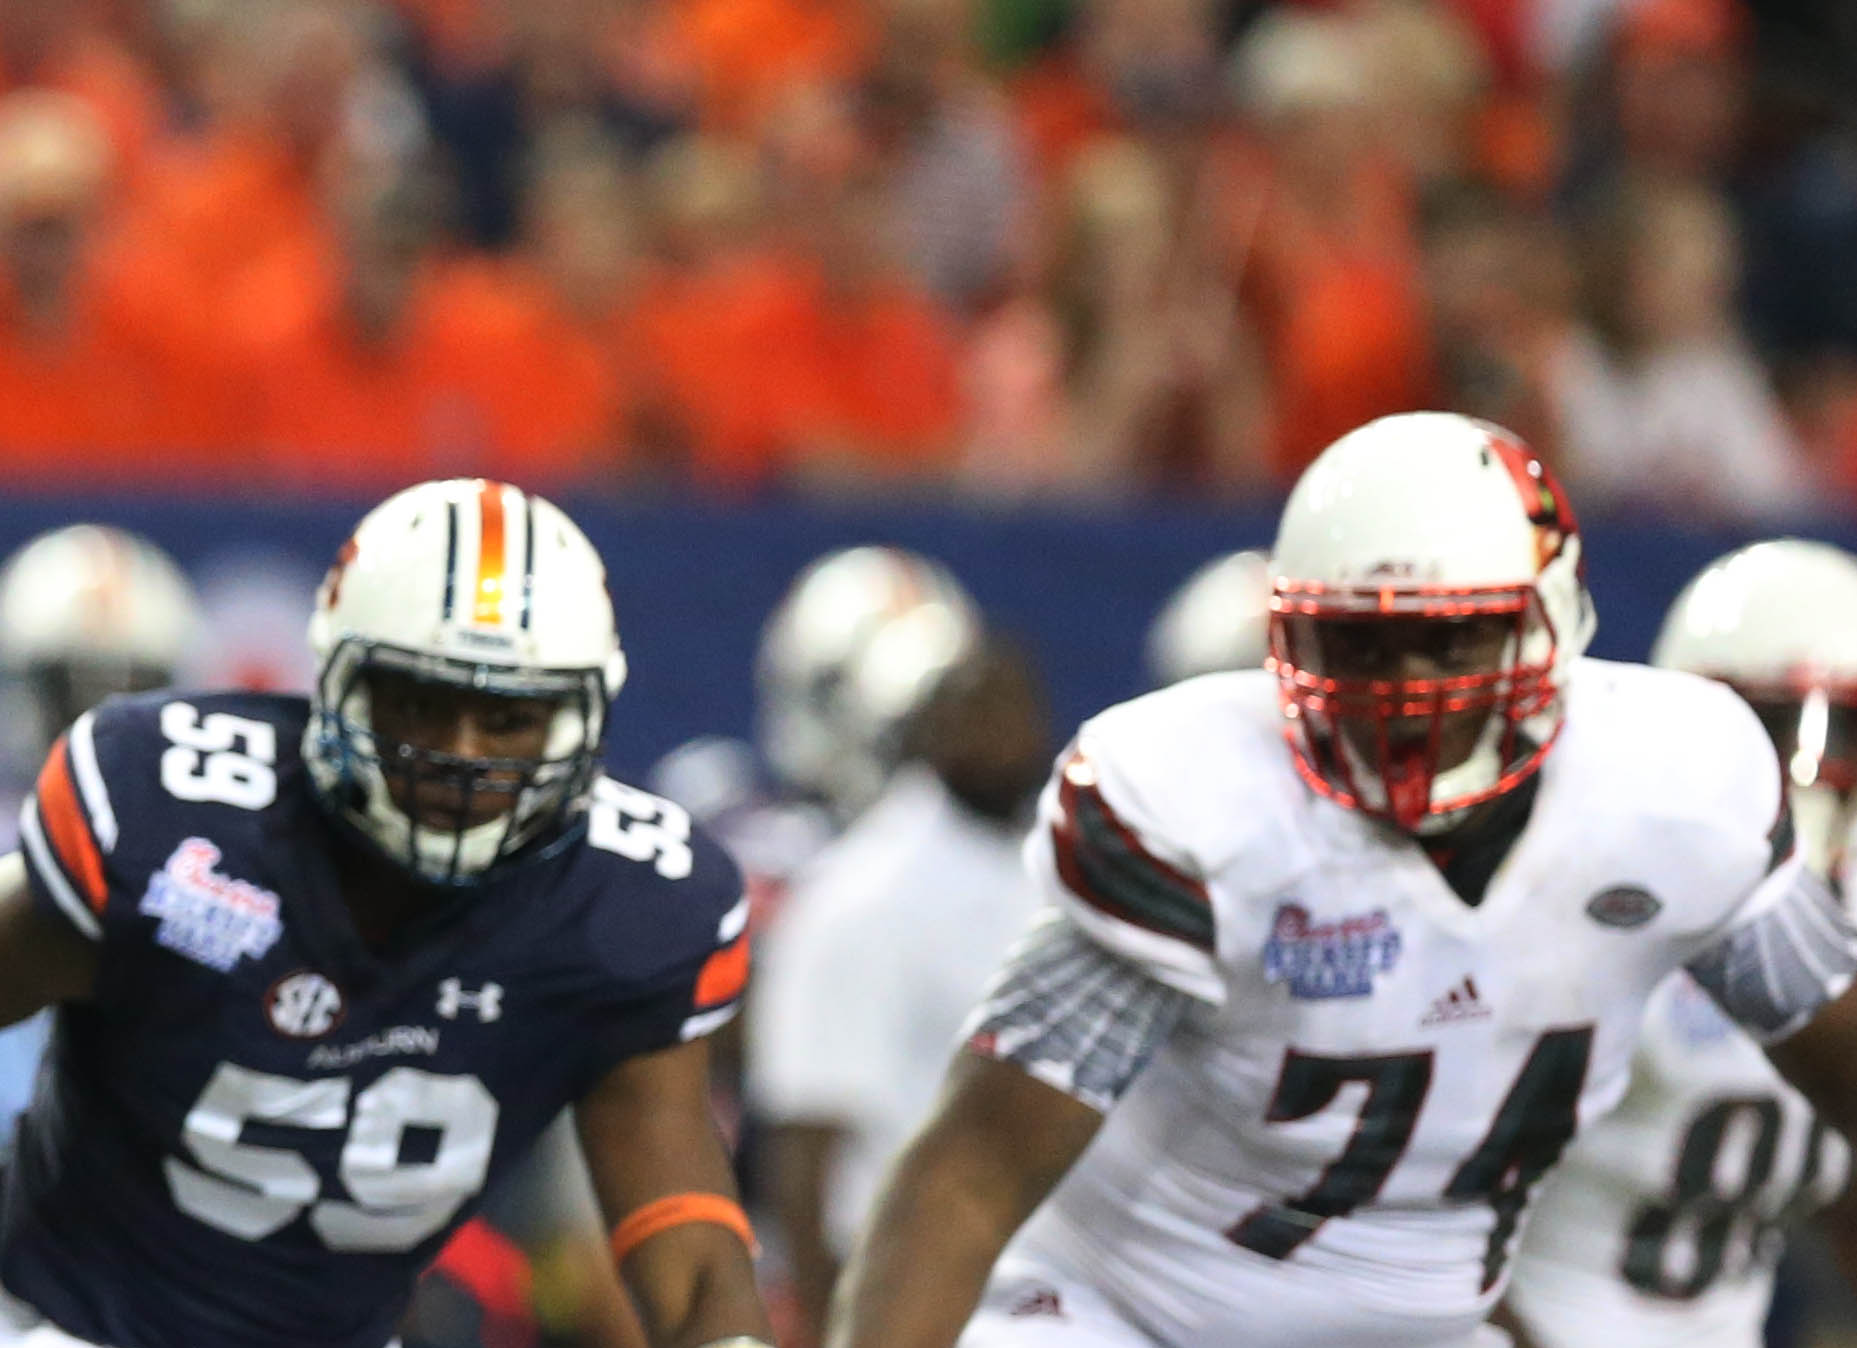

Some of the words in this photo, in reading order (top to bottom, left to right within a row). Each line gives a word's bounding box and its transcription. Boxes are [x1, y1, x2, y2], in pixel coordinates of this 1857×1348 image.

[160, 701, 278, 811] 59
[163, 1060, 500, 1252] 59
[1223, 1018, 1597, 1297] 74
